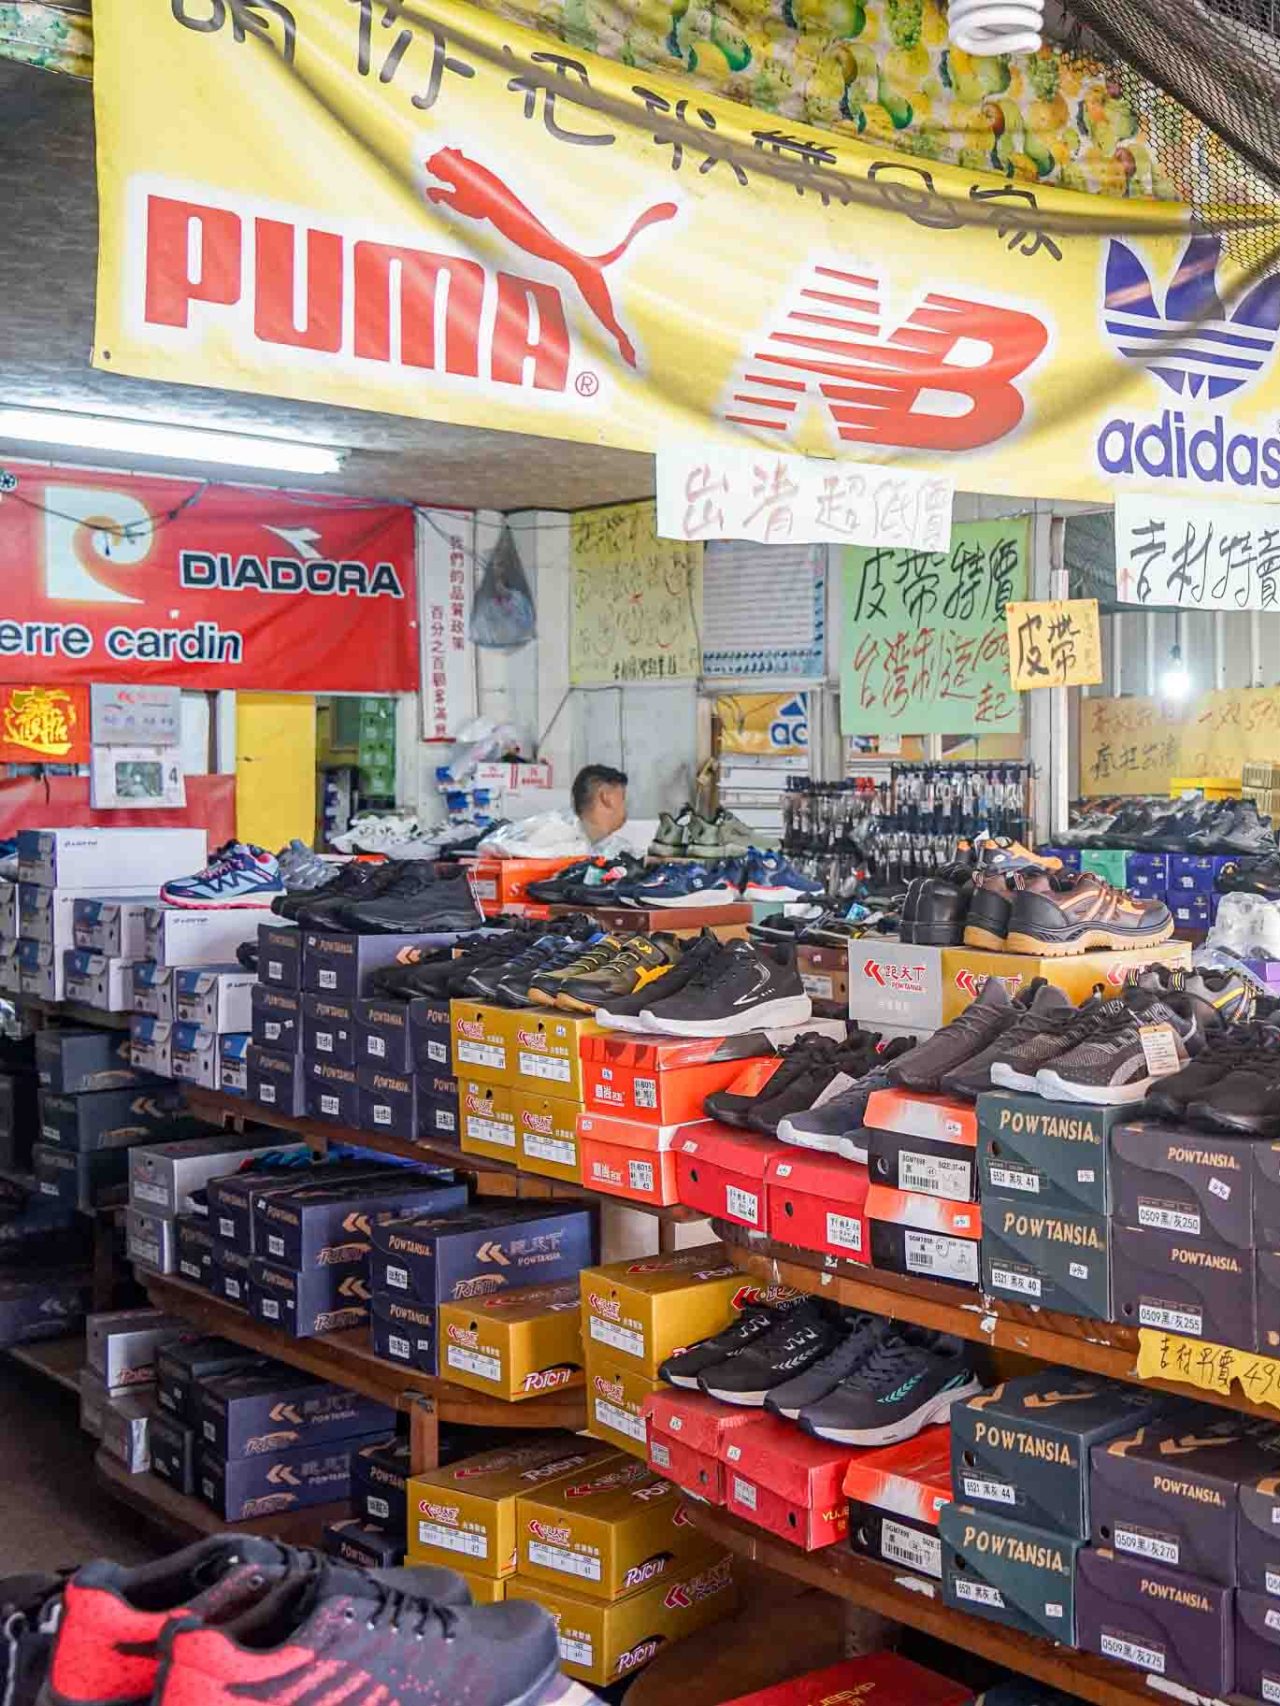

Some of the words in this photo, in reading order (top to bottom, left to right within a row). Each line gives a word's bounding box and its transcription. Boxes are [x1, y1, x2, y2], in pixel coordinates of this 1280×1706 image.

[144, 194, 570, 393] PUMA
[180, 551, 403, 598] DIADORA
[108, 621, 243, 663] cardin
[1018, 613, 1080, 682] 皮帶
[885, 964, 926, 982] 跑天下
[1000, 1109, 1094, 1144] POWTANSIA
[1168, 1147, 1235, 1169] POWTANSIA
[389, 1235, 432, 1256] POWTANSIA
[1004, 1211, 1099, 1248] POWTANSIA
[1171, 1248, 1238, 1273] POWTANSIA
[389, 1304, 432, 1324] POWTANSIA
[975, 1421, 1071, 1466] POWTANSIA
[1001, 1487, 1011, 1499] 44
[1153, 1475, 1223, 1506] POWTANSIA
[964, 1526, 1064, 1573] POWTANSIA
[1140, 1579, 1211, 1610] POWTANSIA
